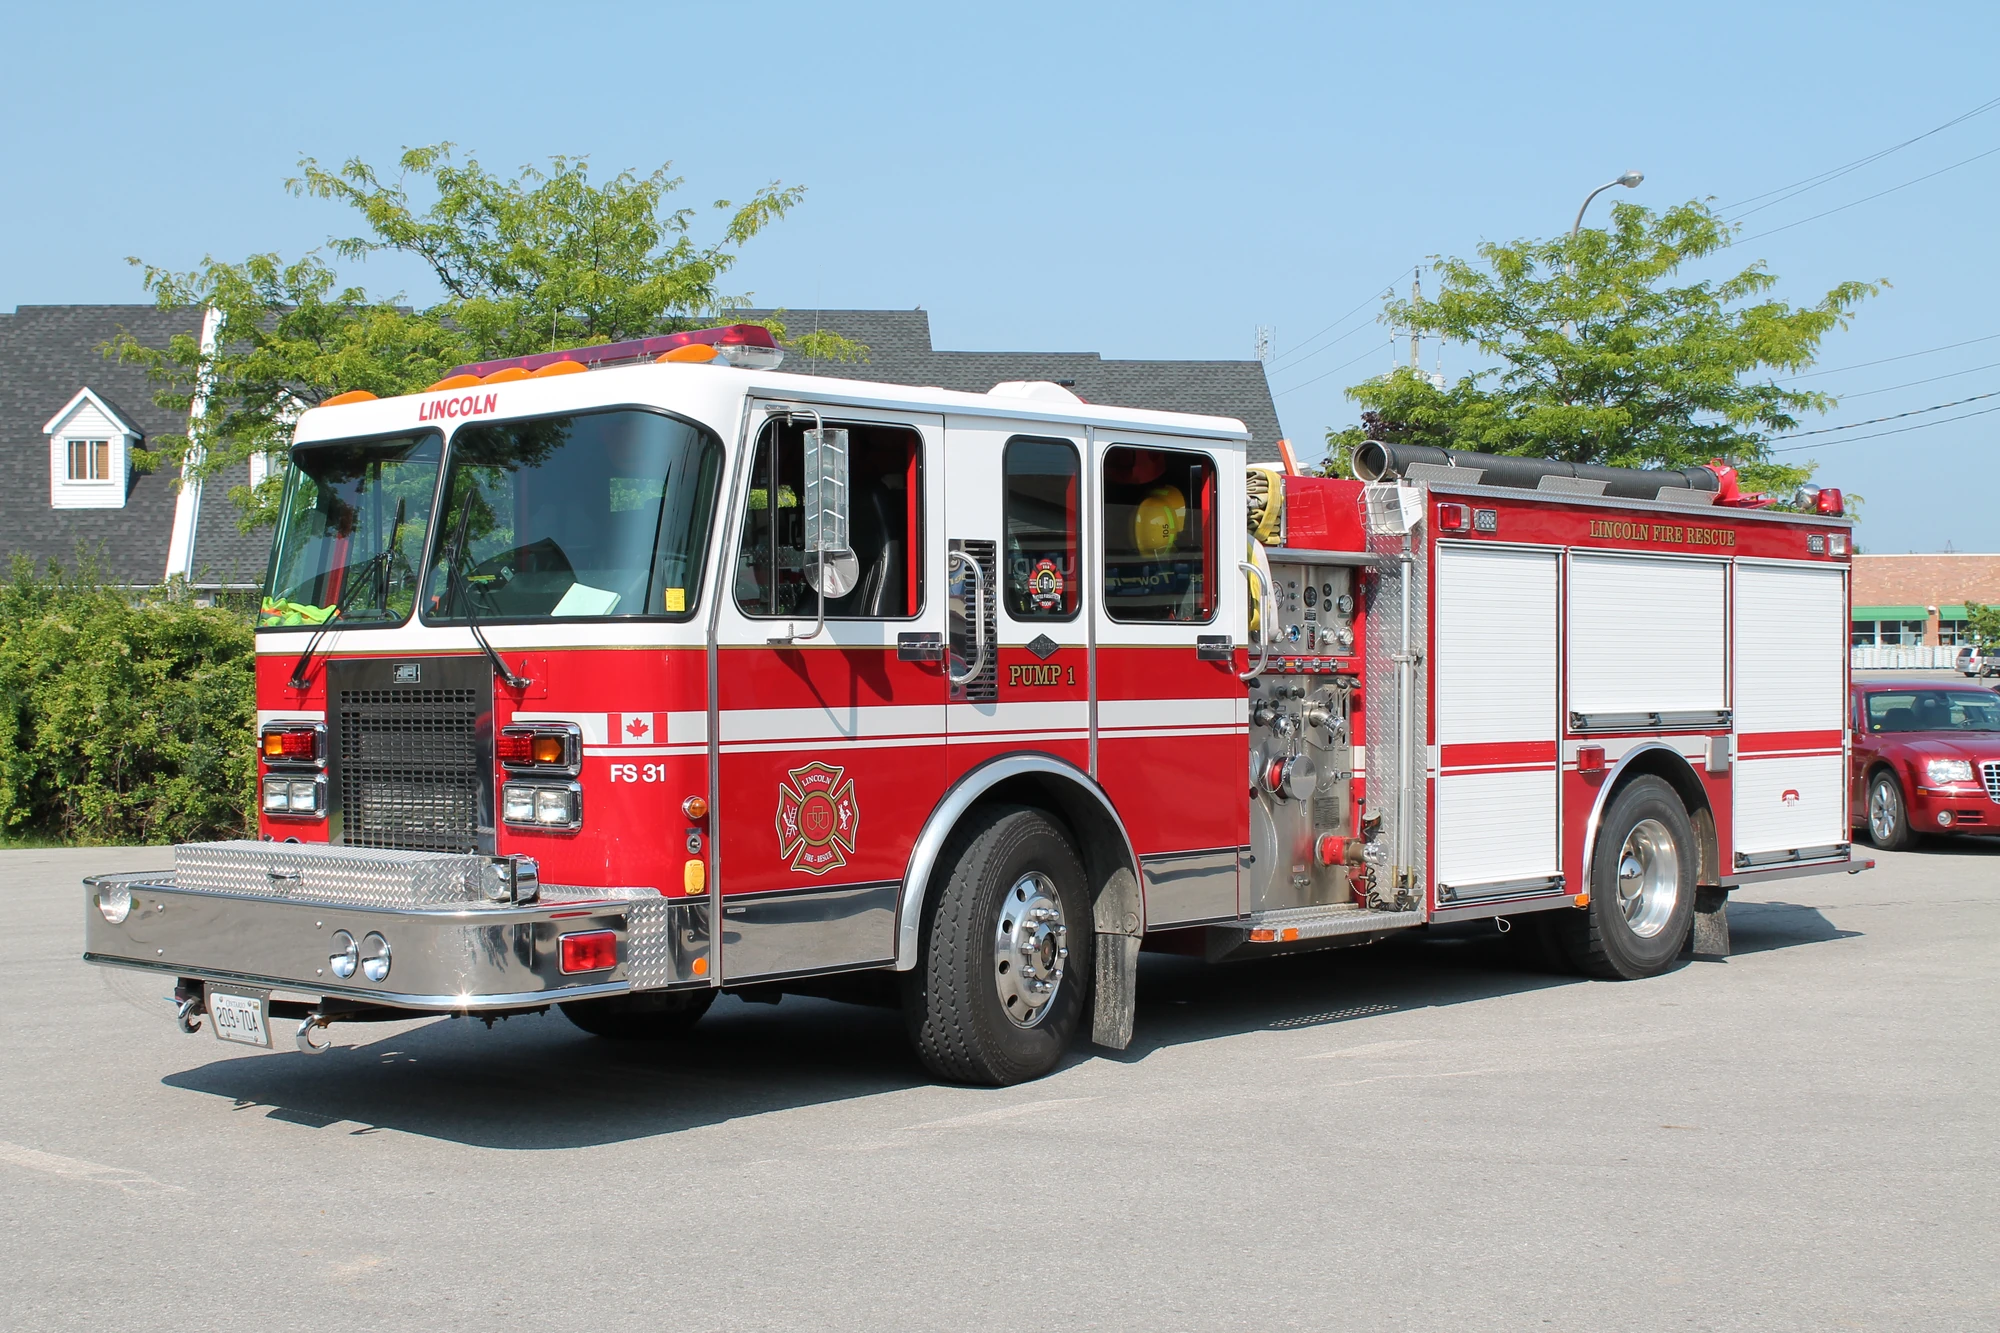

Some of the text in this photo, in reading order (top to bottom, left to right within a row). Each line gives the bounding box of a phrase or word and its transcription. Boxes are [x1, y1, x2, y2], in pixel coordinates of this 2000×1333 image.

[419, 393, 497, 421] LINCOLN
[1590, 520, 1735, 546] LINCOLN FIRE RESCUE
[1039, 577, 1054, 590] LFD
[1009, 665, 1075, 686] PUMP 1
[610, 763, 665, 783] FS 31
[801, 774, 832, 787] LINCOLN
[804, 852, 814, 862] FIRE
[817, 850, 833, 863] RESCUE
